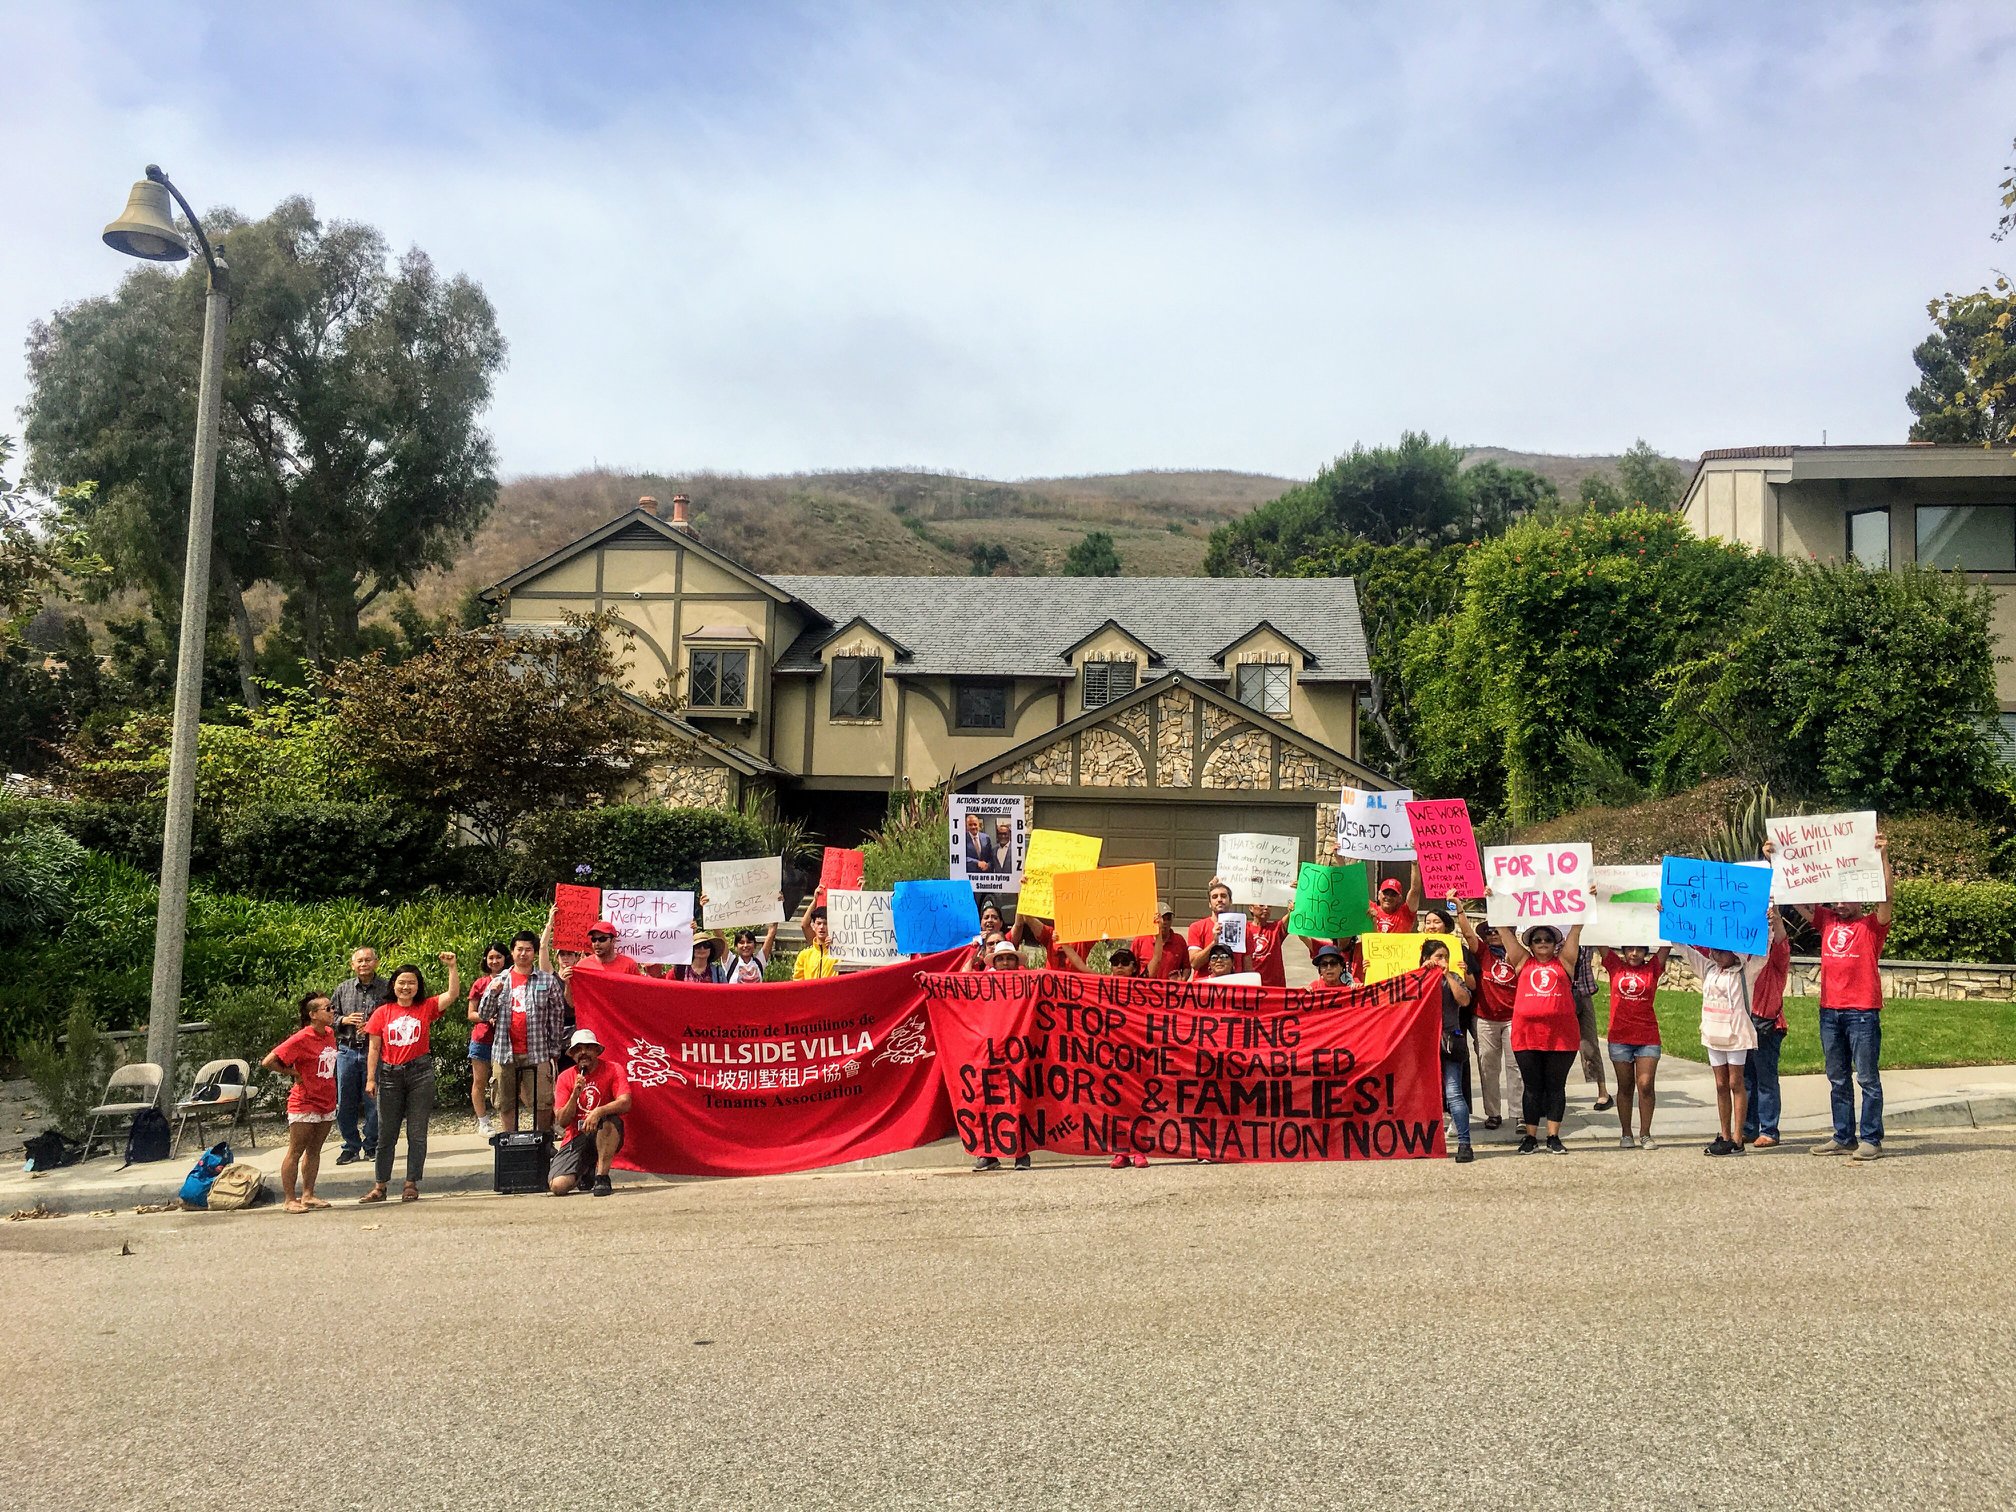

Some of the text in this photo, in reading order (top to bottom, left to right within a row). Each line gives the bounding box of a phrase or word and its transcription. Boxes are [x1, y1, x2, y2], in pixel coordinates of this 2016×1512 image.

[956, 797, 980, 805] ACTIONS
[981, 797, 999, 805] SPEAK
[1409, 806, 1468, 821] WE WORK
[1416, 824, 1461, 837] HARD TO
[1834, 821, 1854, 836] NOT
[1256, 841, 1269, 850] all
[1419, 839, 1467, 849] MAKE ENDS
[1423, 853, 1462, 861] MEET AND
[1494, 854, 1536, 877] FOR
[1548, 852, 1578, 875] 10
[1446, 864, 1460, 872] NOT
[1666, 862, 1750, 895] Let the
[715, 868, 769, 890] HOMELESS
[1300, 866, 1345, 896] STOP
[651, 897, 678, 913] the
[706, 895, 763, 913] TOM BOTZ
[830, 894, 862, 912] TOM
[867, 895, 893, 911] AN
[1307, 894, 1342, 914] the
[1512, 889, 1586, 917] YEARS
[843, 912, 884, 930] CHLOE
[1665, 912, 1697, 940] Stay
[1722, 916, 1758, 948] Play
[645, 929, 659, 940] to
[660, 930, 681, 940] our
[829, 945, 846, 957] MOS
[848, 946, 855, 957] Y
[857, 947, 868, 957] NO
[870, 948, 885, 957] NOS
[921, 972, 1429, 1012] BRANDON DIMOND NUSSBAUM LLP BOTZ FAMILY
[683, 1014, 875, 1039] Asociación de Inquilinos de
[1036, 1000, 1300, 1048] STOP HURTING
[681, 1031, 874, 1064] HILLSIDE VILLA
[987, 1034, 1356, 1080] LOW INCOME DISABLED
[695, 1059, 861, 1091] 山坡別墅租戶協會
[703, 1083, 862, 1109] Tenants Association
[960, 1064, 1394, 1119] SENIORS & FAMILIES!
[956, 1108, 1046, 1156] SIGN
[1047, 1114, 1080, 1143] THE
[1342, 1119, 1440, 1159] NOW
